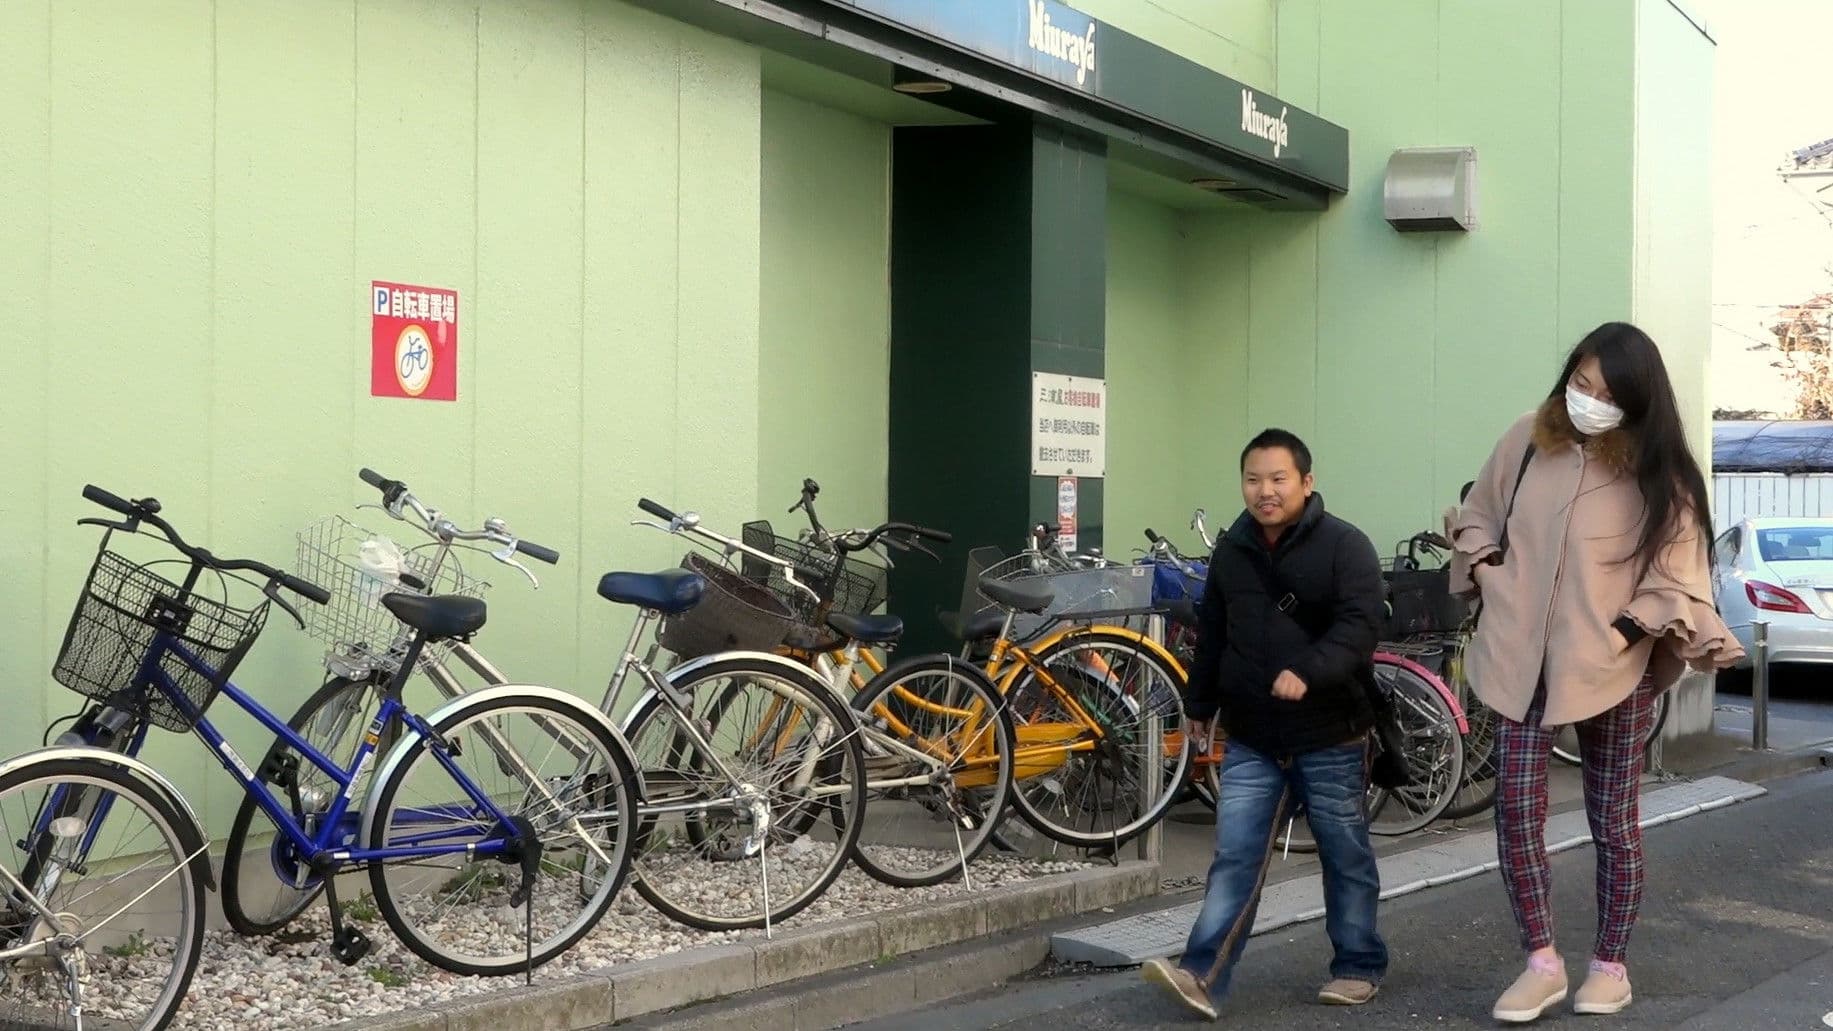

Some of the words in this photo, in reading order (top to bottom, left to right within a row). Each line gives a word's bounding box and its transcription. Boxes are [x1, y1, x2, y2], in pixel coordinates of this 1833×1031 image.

[1028, 0, 1096, 86] Miuraya
[1241, 88, 1288, 158] Miuraya
[377, 289, 388, 313] P
[391, 288, 455, 324] 自転車置場
